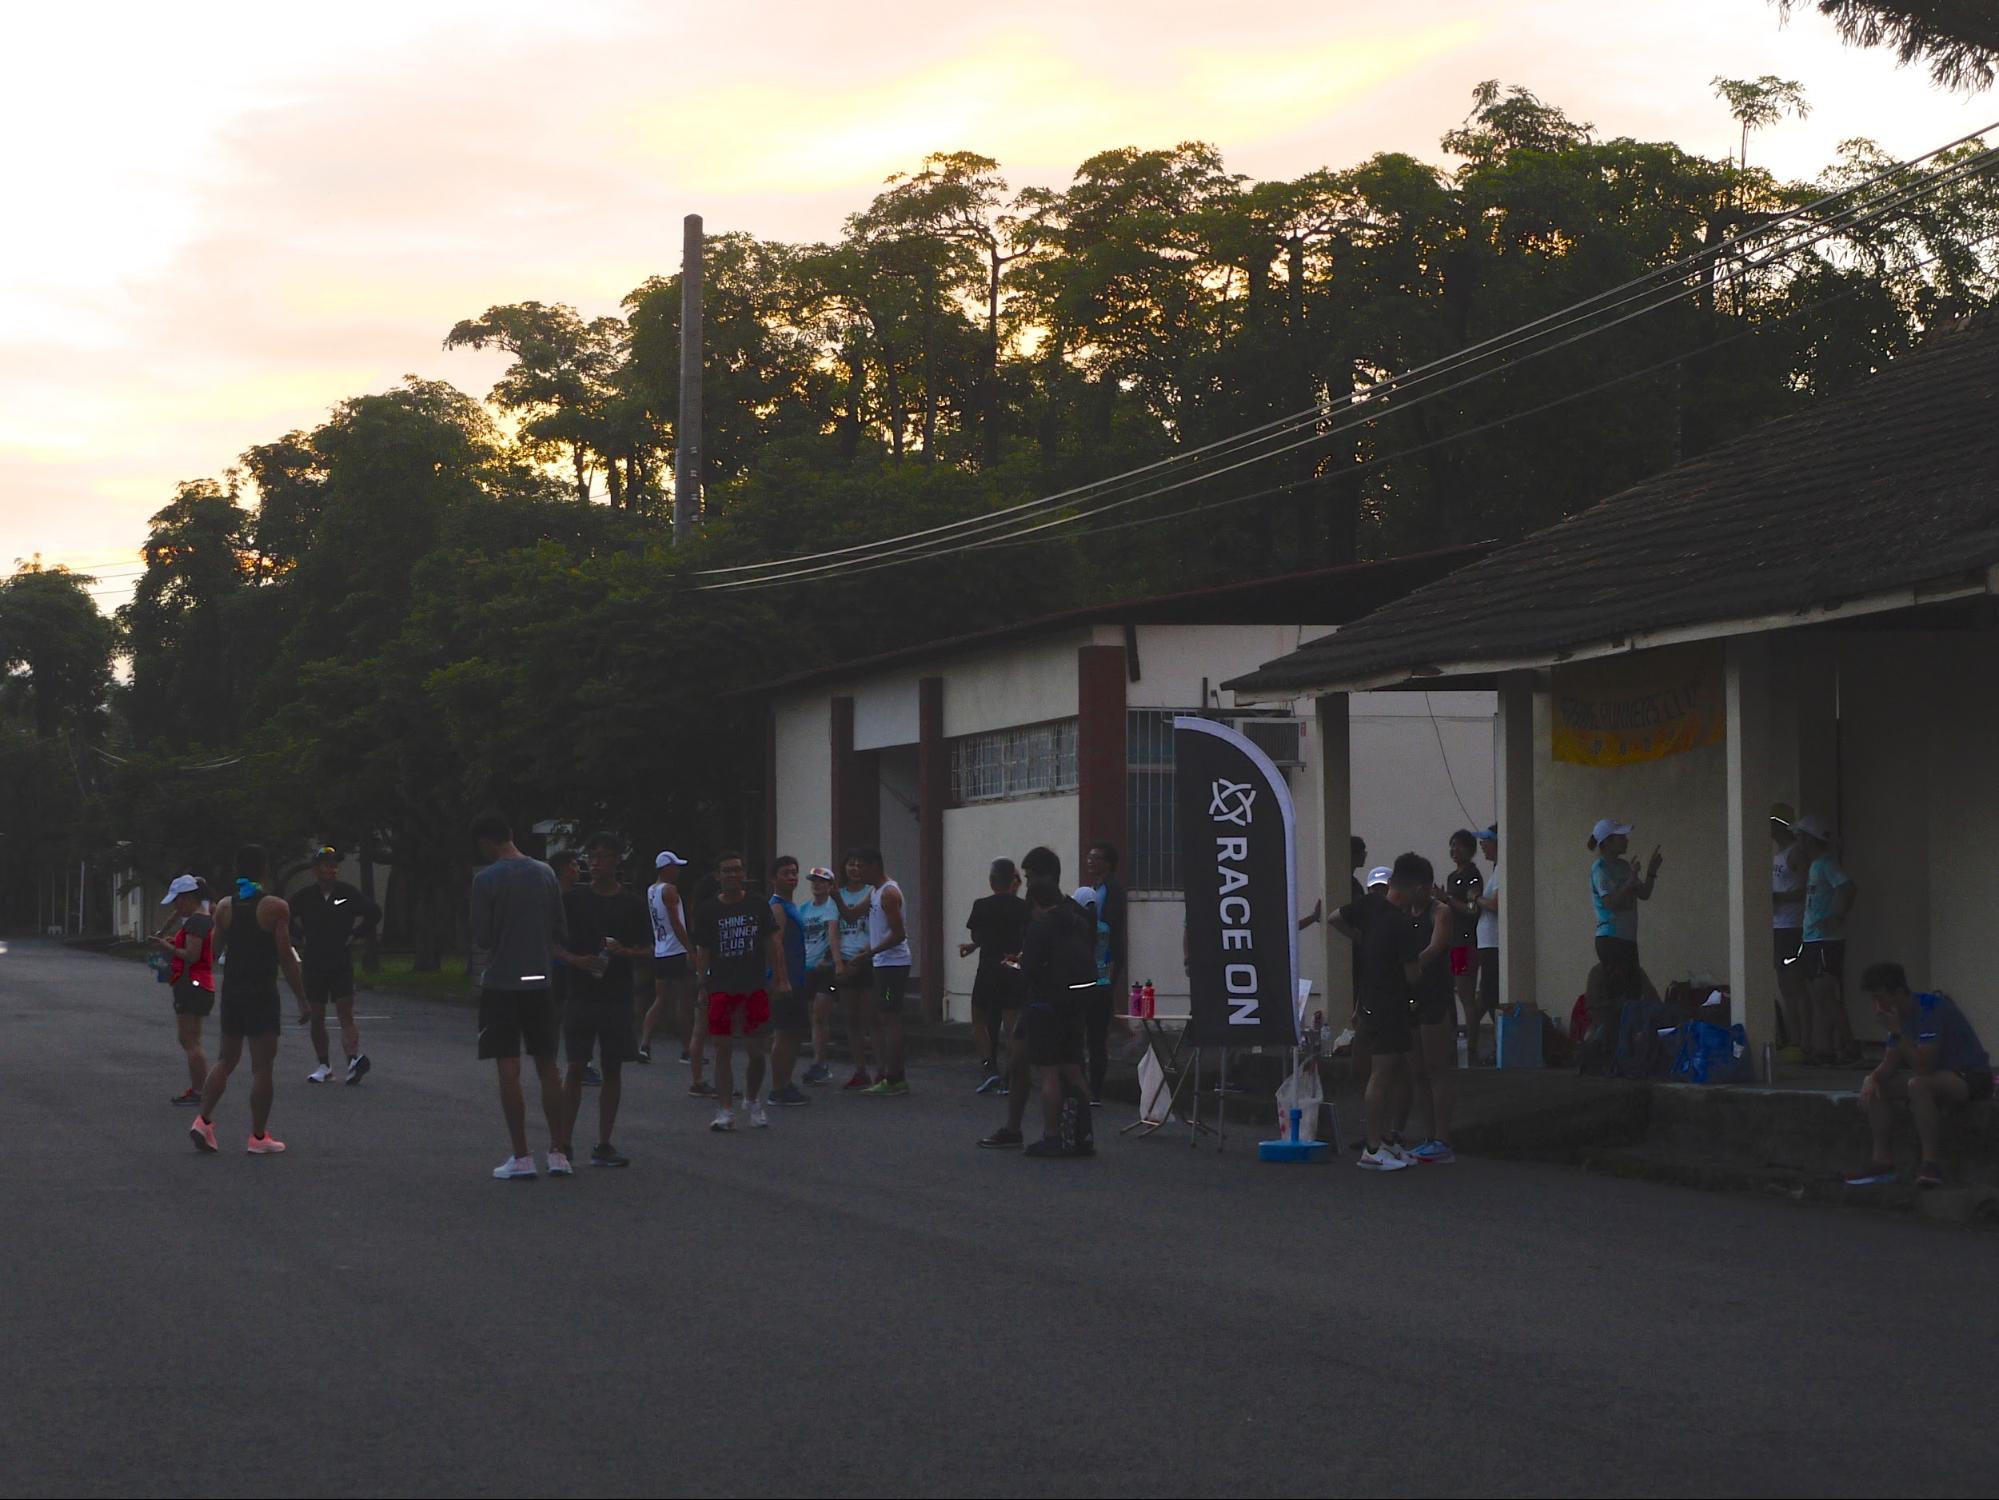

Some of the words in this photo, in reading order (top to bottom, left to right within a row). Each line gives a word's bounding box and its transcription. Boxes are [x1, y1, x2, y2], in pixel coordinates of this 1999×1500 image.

[718, 915, 746, 928] SHINE
[1216, 836, 1253, 950] RACE
[1225, 963, 1261, 1025] ON
